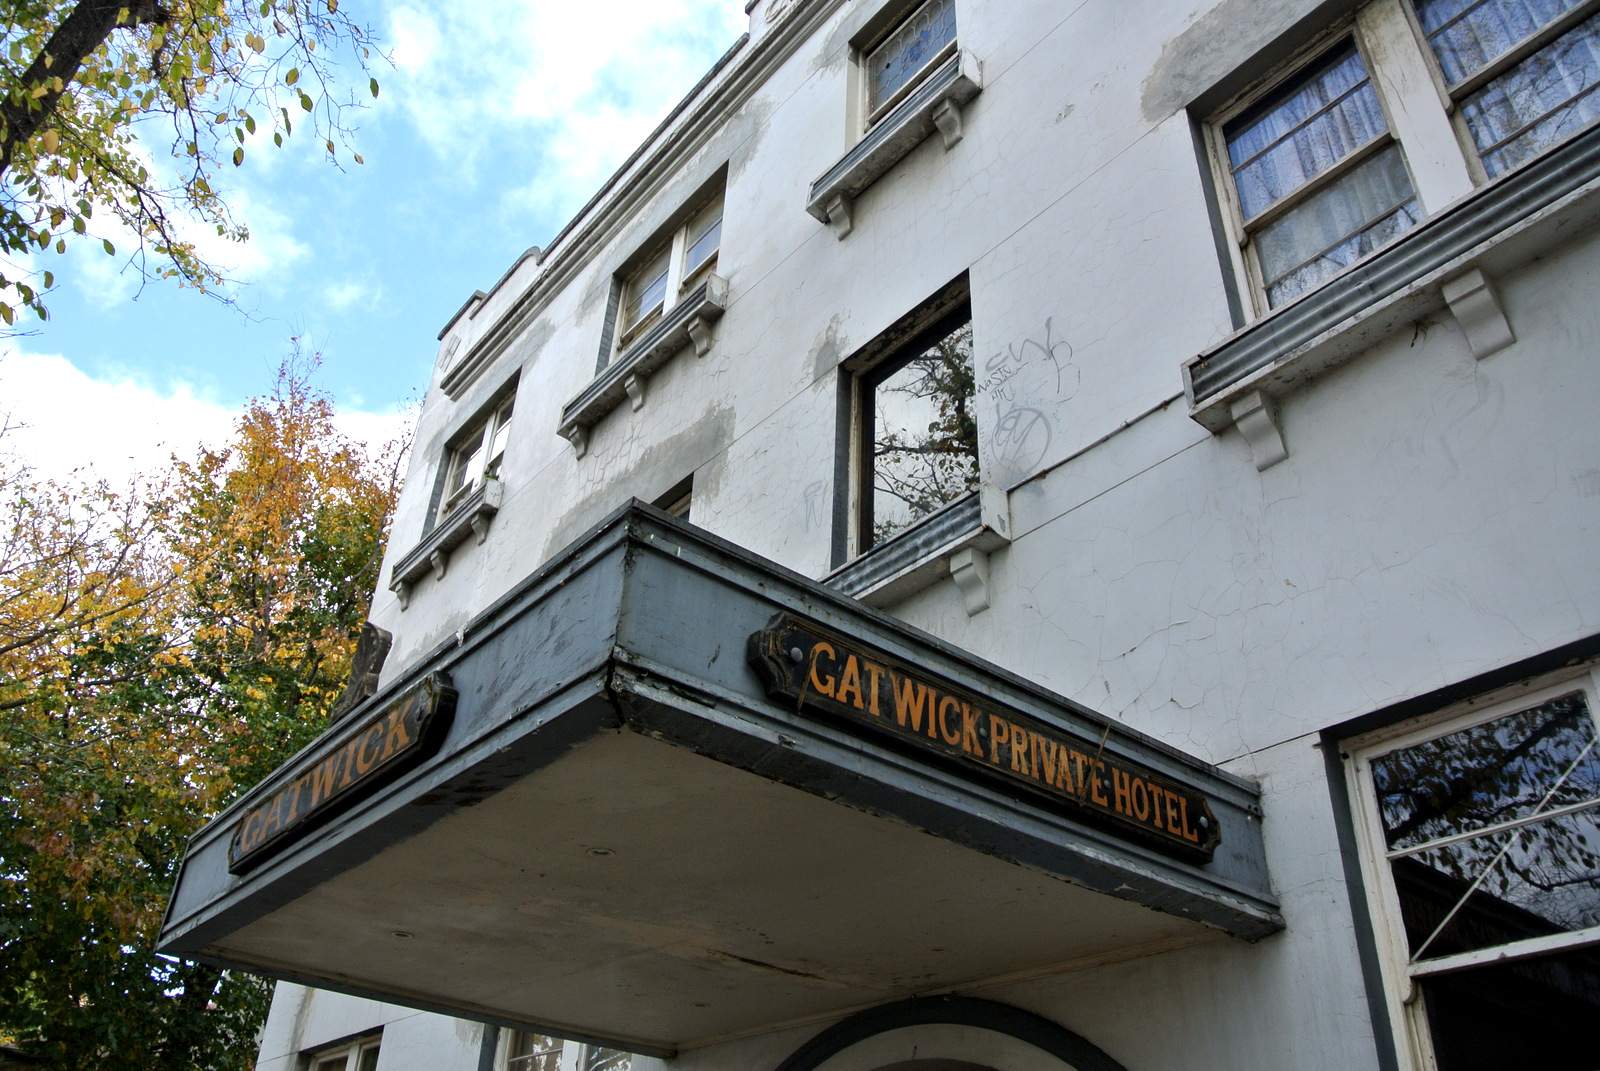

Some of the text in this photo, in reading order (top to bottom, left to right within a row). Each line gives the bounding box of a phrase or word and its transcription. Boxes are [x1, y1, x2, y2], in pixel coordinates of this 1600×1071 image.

[239, 698, 414, 851] GATWICK
[809, 641, 1198, 842] GATWICK PRIVATE HOTEL
